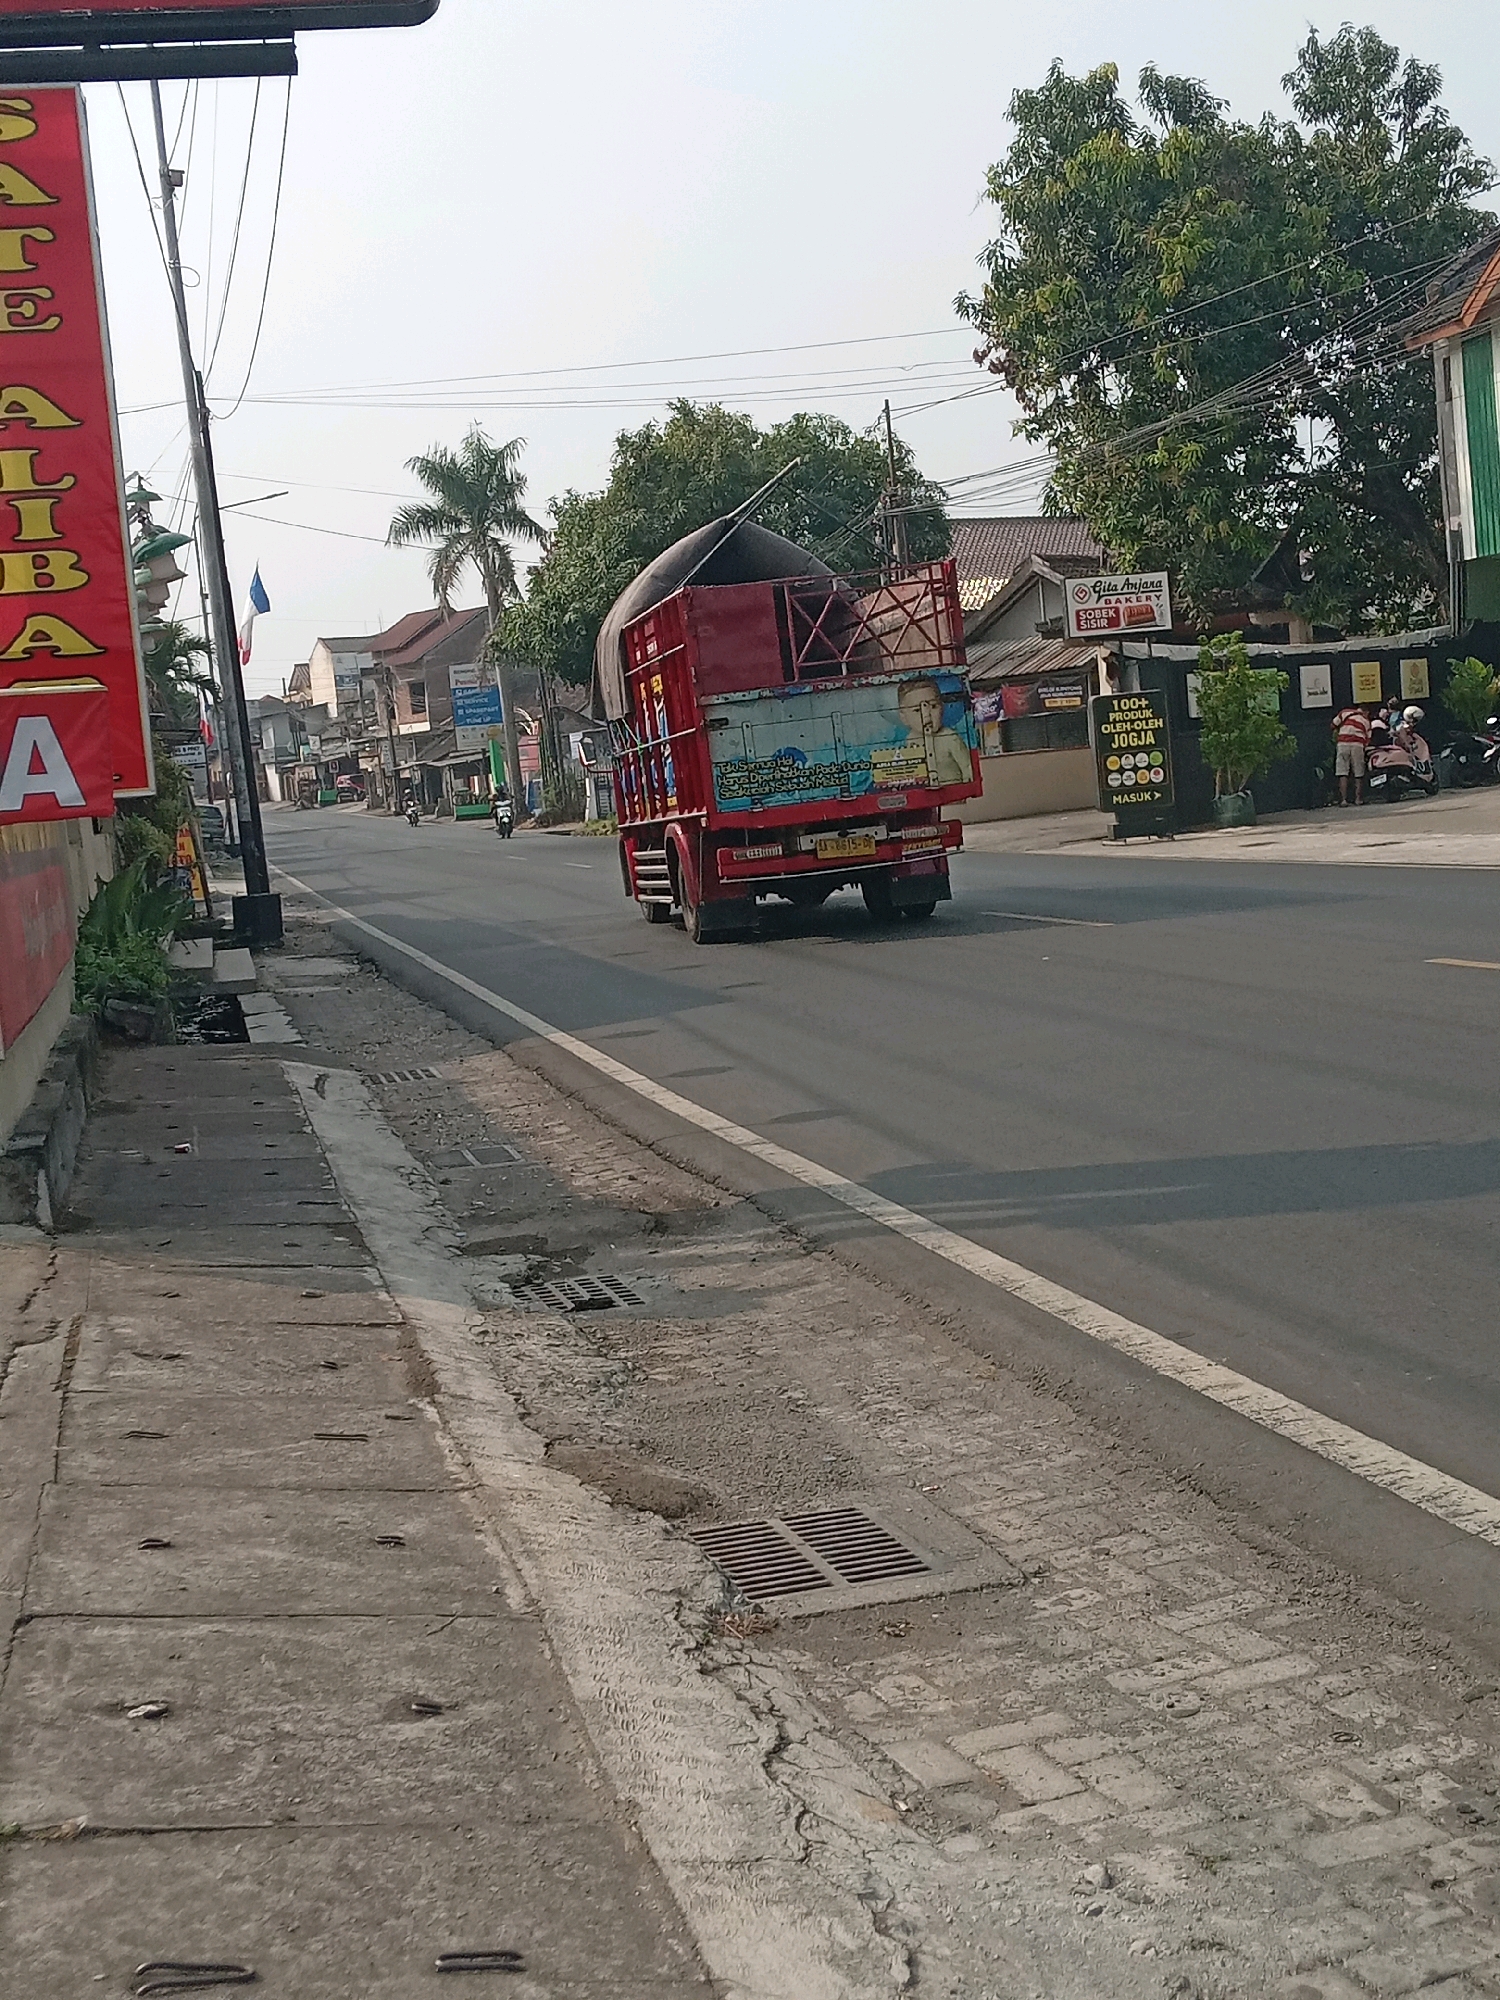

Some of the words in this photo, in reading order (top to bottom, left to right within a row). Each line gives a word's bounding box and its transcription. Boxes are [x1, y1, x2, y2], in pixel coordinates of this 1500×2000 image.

[1090, 580, 1118, 602] Gita
[1120, 577, 1163, 594] Anjana
[1104, 594, 1162, 605] BAKERY
[1079, 608, 1116, 620] SOBEK
[1080, 619, 1109, 629] SISIR
[1112, 697, 1149, 711] 100+
[1108, 708, 1153, 722] PRODUK
[1101, 718, 1164, 734] OLEH-OLEH
[1111, 730, 1155, 749] JOGJA
[1112, 791, 1152, 805] MASUK
